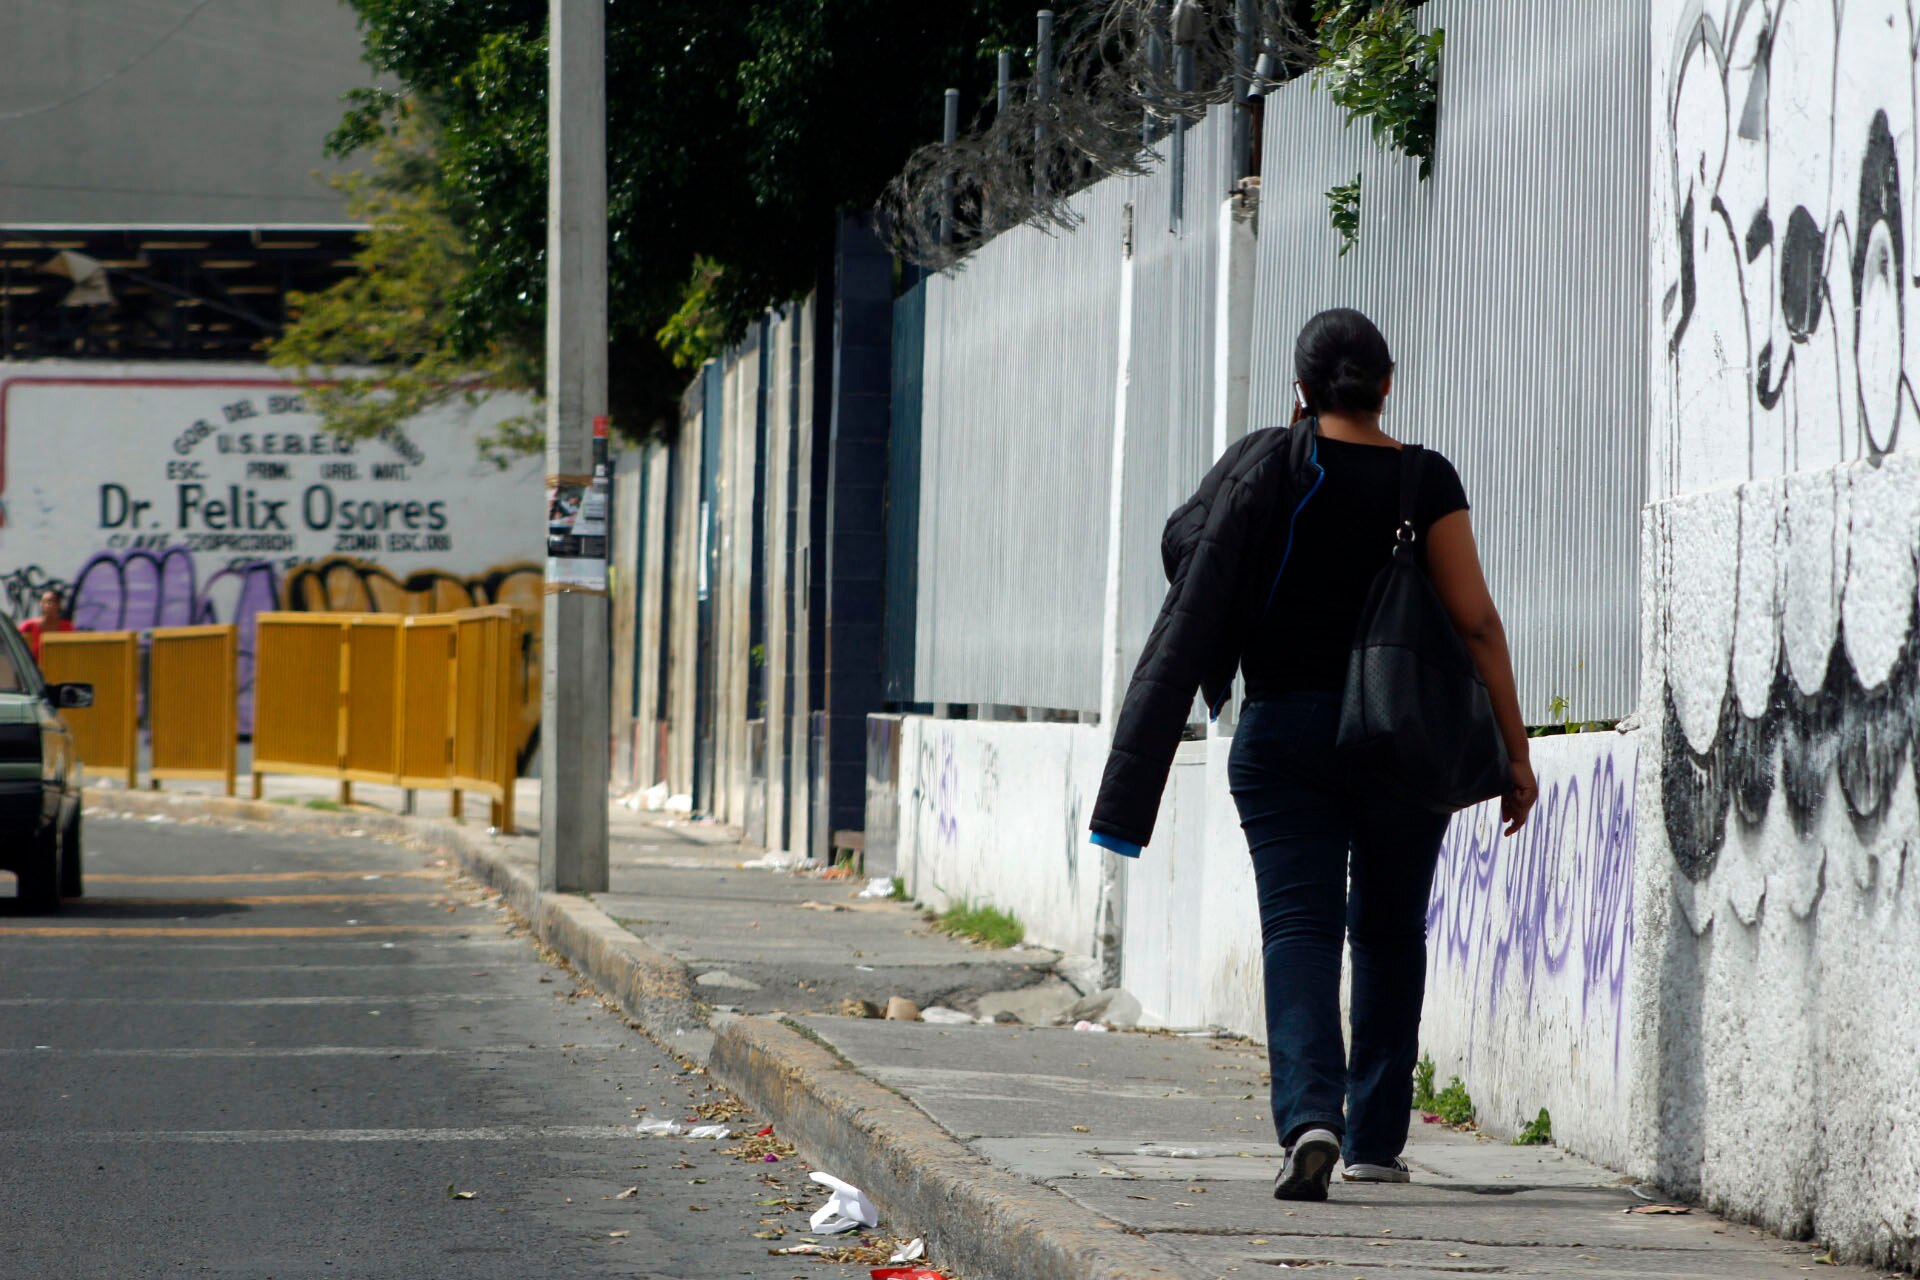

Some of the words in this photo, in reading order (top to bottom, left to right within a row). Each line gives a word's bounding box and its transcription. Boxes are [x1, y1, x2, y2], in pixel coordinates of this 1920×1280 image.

[166, 461, 209, 480] ESC.
[99, 483, 161, 530] Dr.
[177, 483, 288, 531] Felix
[303, 483, 448, 532] Osores
